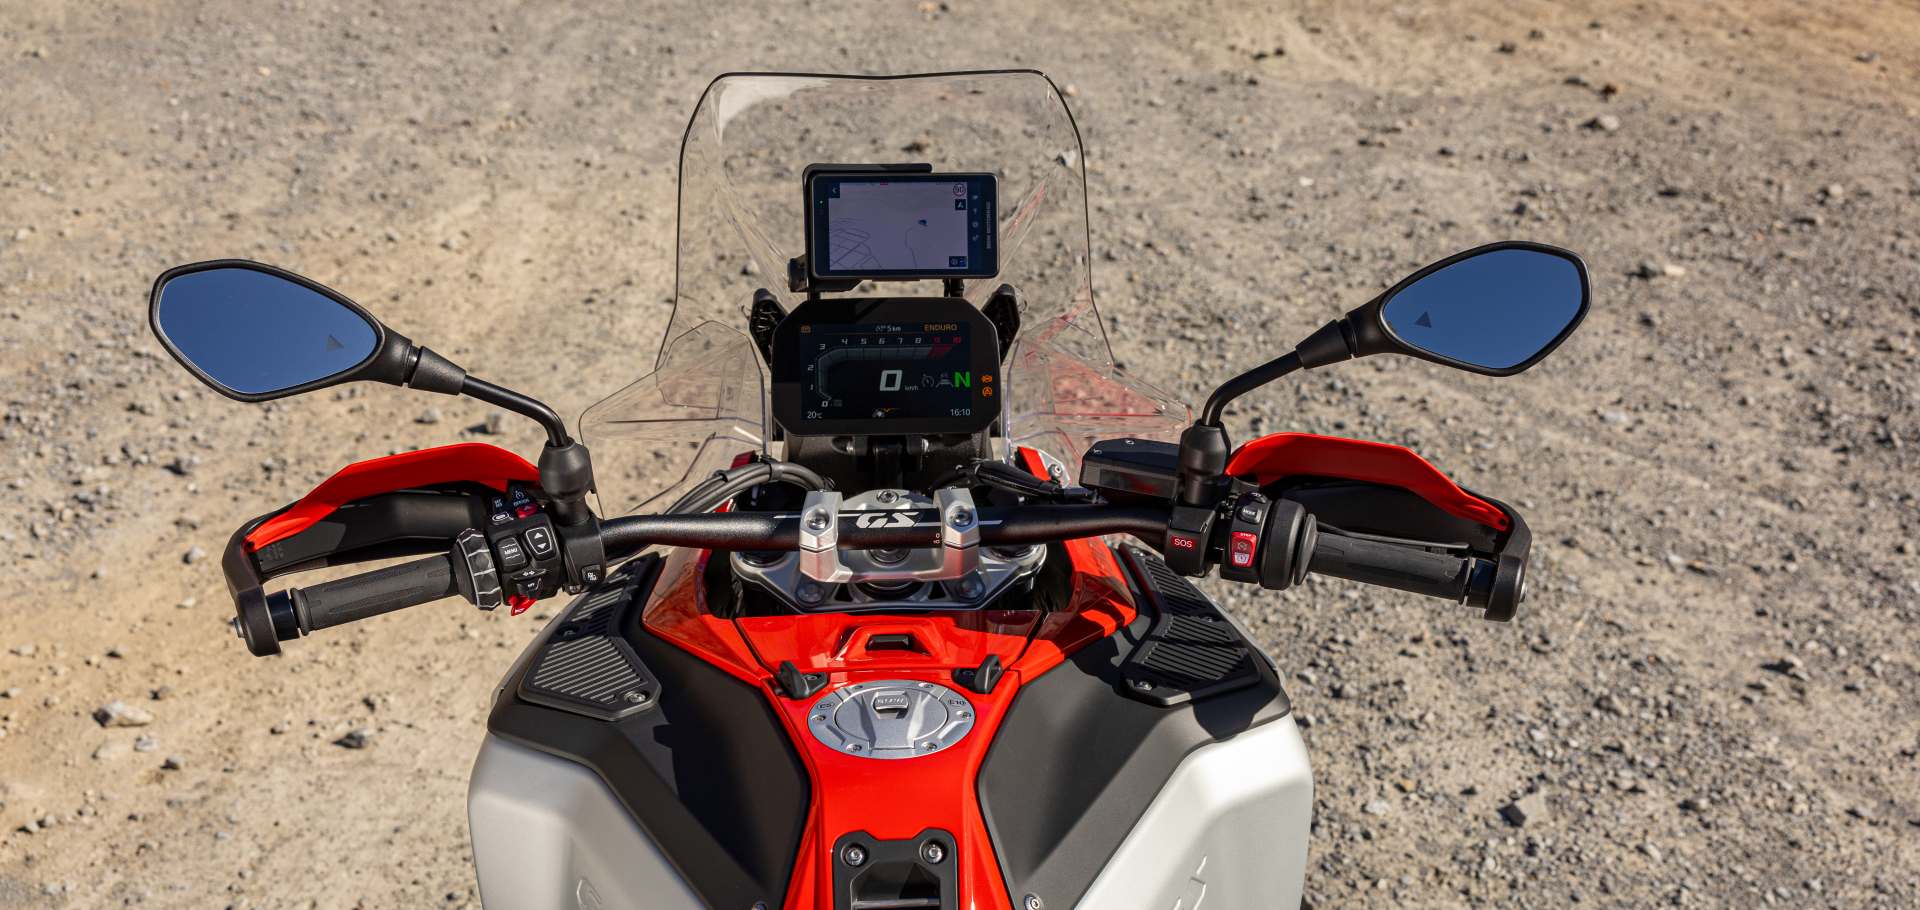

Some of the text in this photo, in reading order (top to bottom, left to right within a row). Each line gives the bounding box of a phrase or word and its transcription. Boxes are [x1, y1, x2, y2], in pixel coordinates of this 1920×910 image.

[924, 323, 958, 331] ENDURO
[880, 370, 903, 391] 0
[954, 371, 971, 388] N
[950, 408, 971, 416] 16:10
[856, 512, 919, 528] GS
[1174, 538, 1193, 548] SOS
[504, 547, 518, 555] MENU
